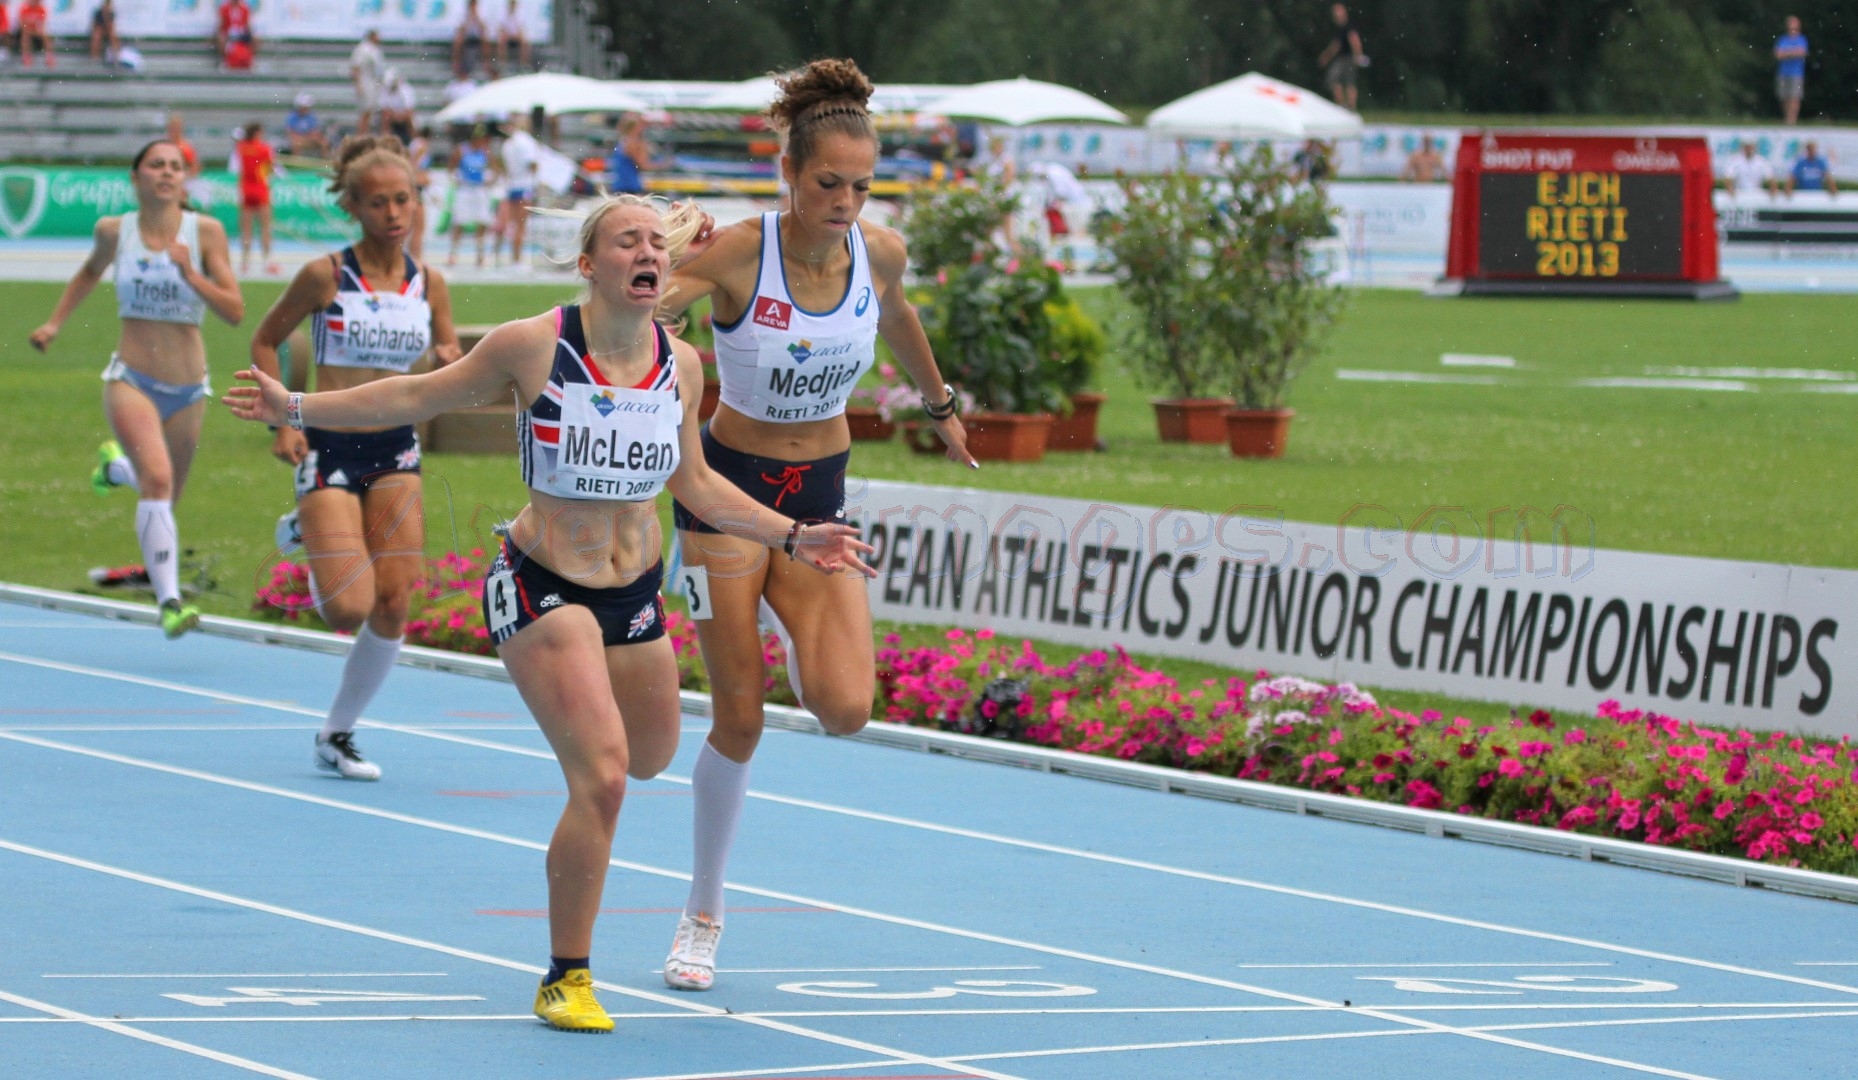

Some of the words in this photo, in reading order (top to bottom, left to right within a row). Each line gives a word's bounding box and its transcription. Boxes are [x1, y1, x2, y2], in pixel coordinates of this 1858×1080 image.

[1481, 148, 1532, 169] SHOT
[1534, 148, 1575, 169] PUT
[1612, 150, 1680, 171] OMEGA
[1537, 171, 1621, 205] EJCH
[1526, 206, 1628, 241] RIETI
[1536, 241, 1620, 277] 2013
[348, 320, 424, 351] Richards
[756, 314, 788, 328] AREVA
[769, 360, 860, 399] Medjid
[616, 400, 660, 414] acea
[765, 405, 808, 420] RIETI
[564, 425, 674, 472] McLean
[575, 477, 620, 495] RIETI
[624, 481, 655, 496] 2013
[494, 579, 507, 616] 4
[685, 575, 700, 612] 3
[974, 533, 1200, 640] ATHLETICS
[1199, 559, 1381, 664] JUNIOR
[1388, 578, 1838, 716] CHAMPIONSHIPS
